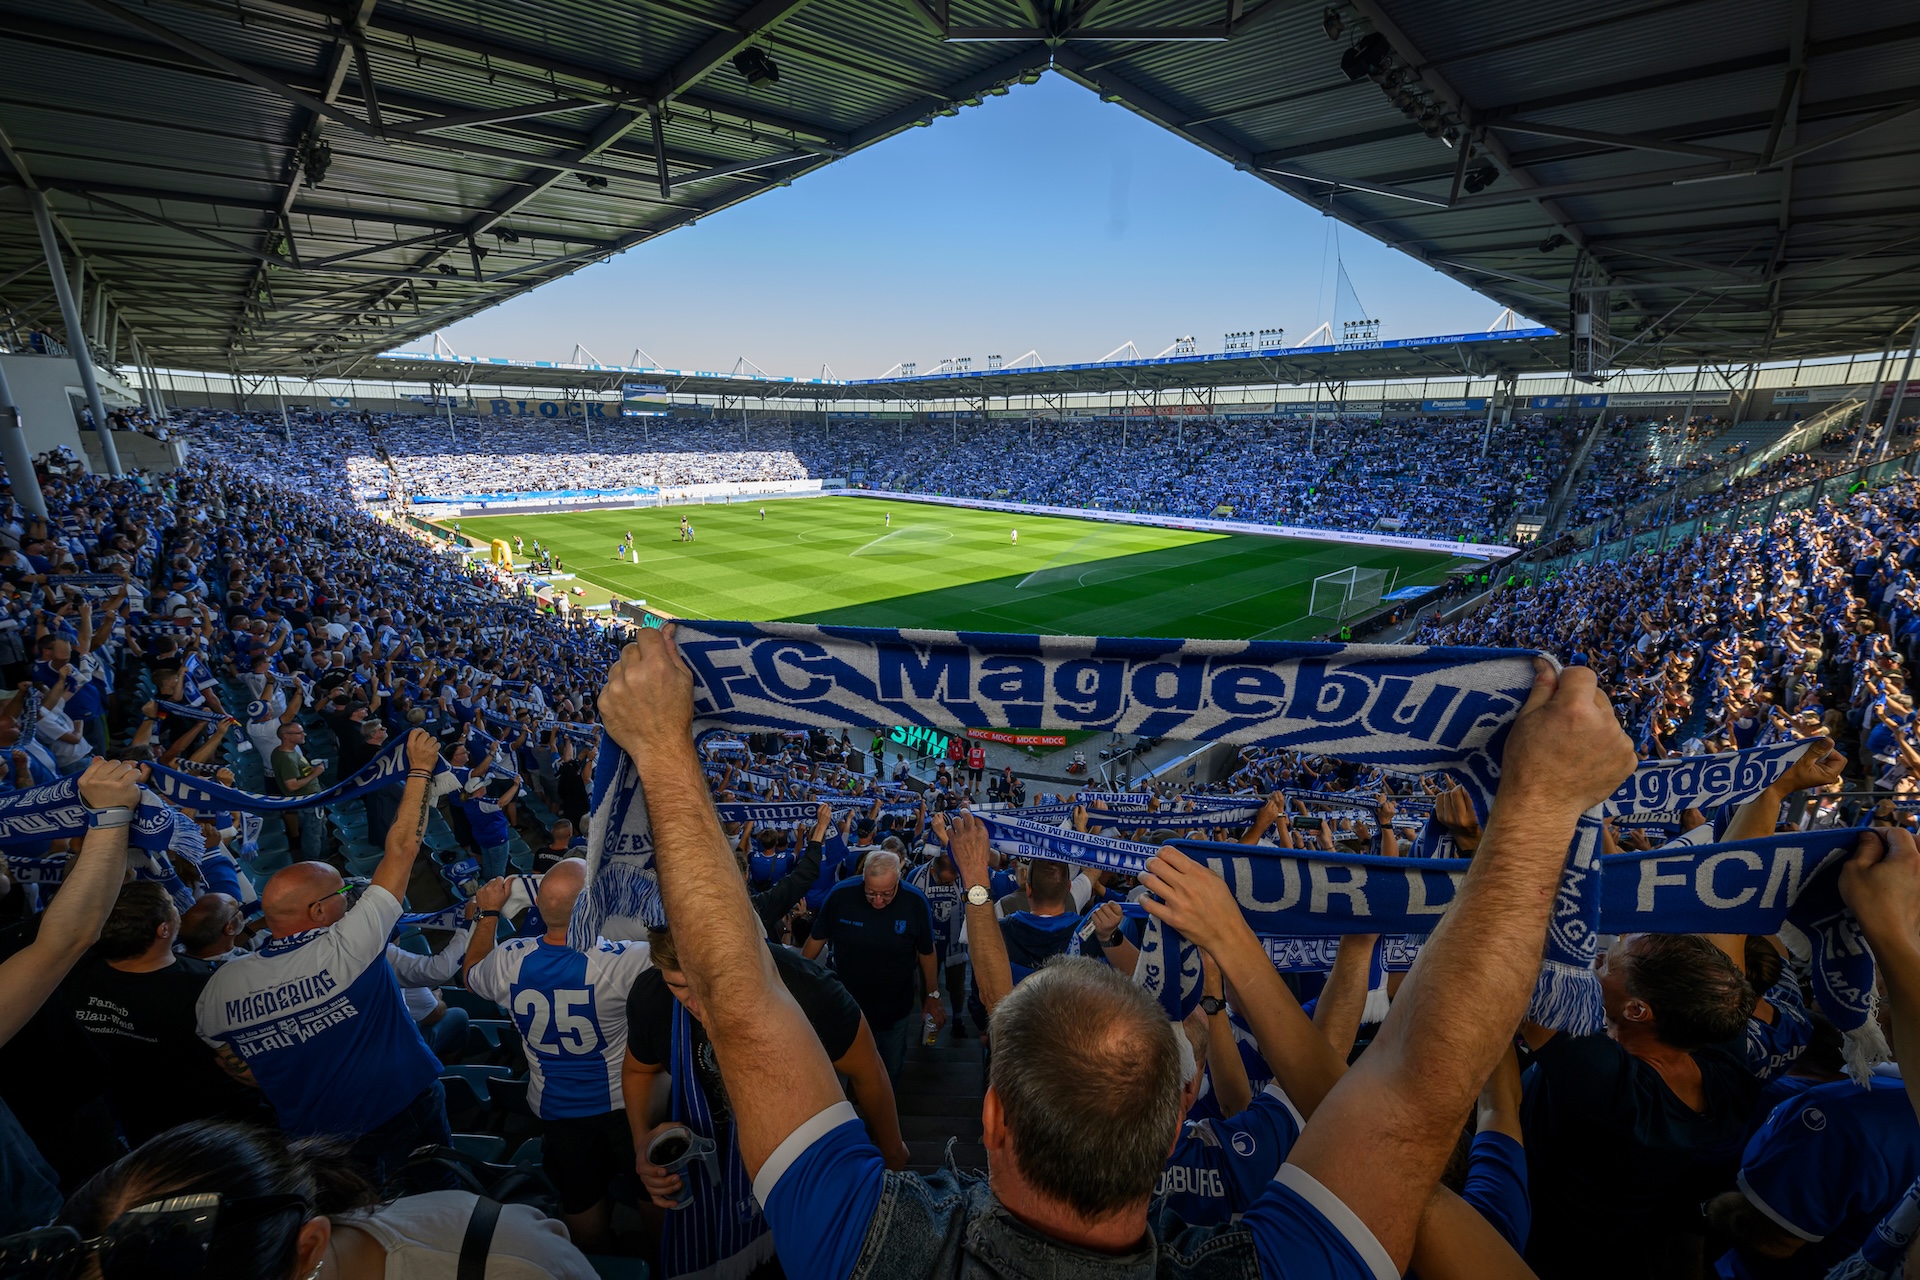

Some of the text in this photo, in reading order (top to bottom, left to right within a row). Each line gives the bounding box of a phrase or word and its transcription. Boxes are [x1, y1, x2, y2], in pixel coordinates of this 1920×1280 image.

[1406, 338, 1430, 346] Prinzke
[1432, 337, 1439, 345] &
[1440, 335, 1465, 343] Partner
[491, 399, 605, 418] BLOCK
[1345, 401, 1382, 410] SCHUBERT
[1432, 400, 1467, 408] Pergande
[642, 613, 663, 629] SW
[870, 640, 1522, 753] Magdebur
[890, 725, 949, 759] SWM
[968, 730, 1064, 745] MDCC MDCC MDCC MDCC
[1609, 754, 1803, 811] agdebu
[1087, 793, 1151, 805] MAGDEBUR
[743, 804, 817, 822] imme
[1048, 826, 1062, 836] IM
[1064, 829, 1086, 842] DICH
[1018, 844, 1030, 855] OB
[1031, 845, 1043, 857] DU
[224, 968, 337, 1027] MAGDEBURG
[513, 988, 599, 1056] 25
